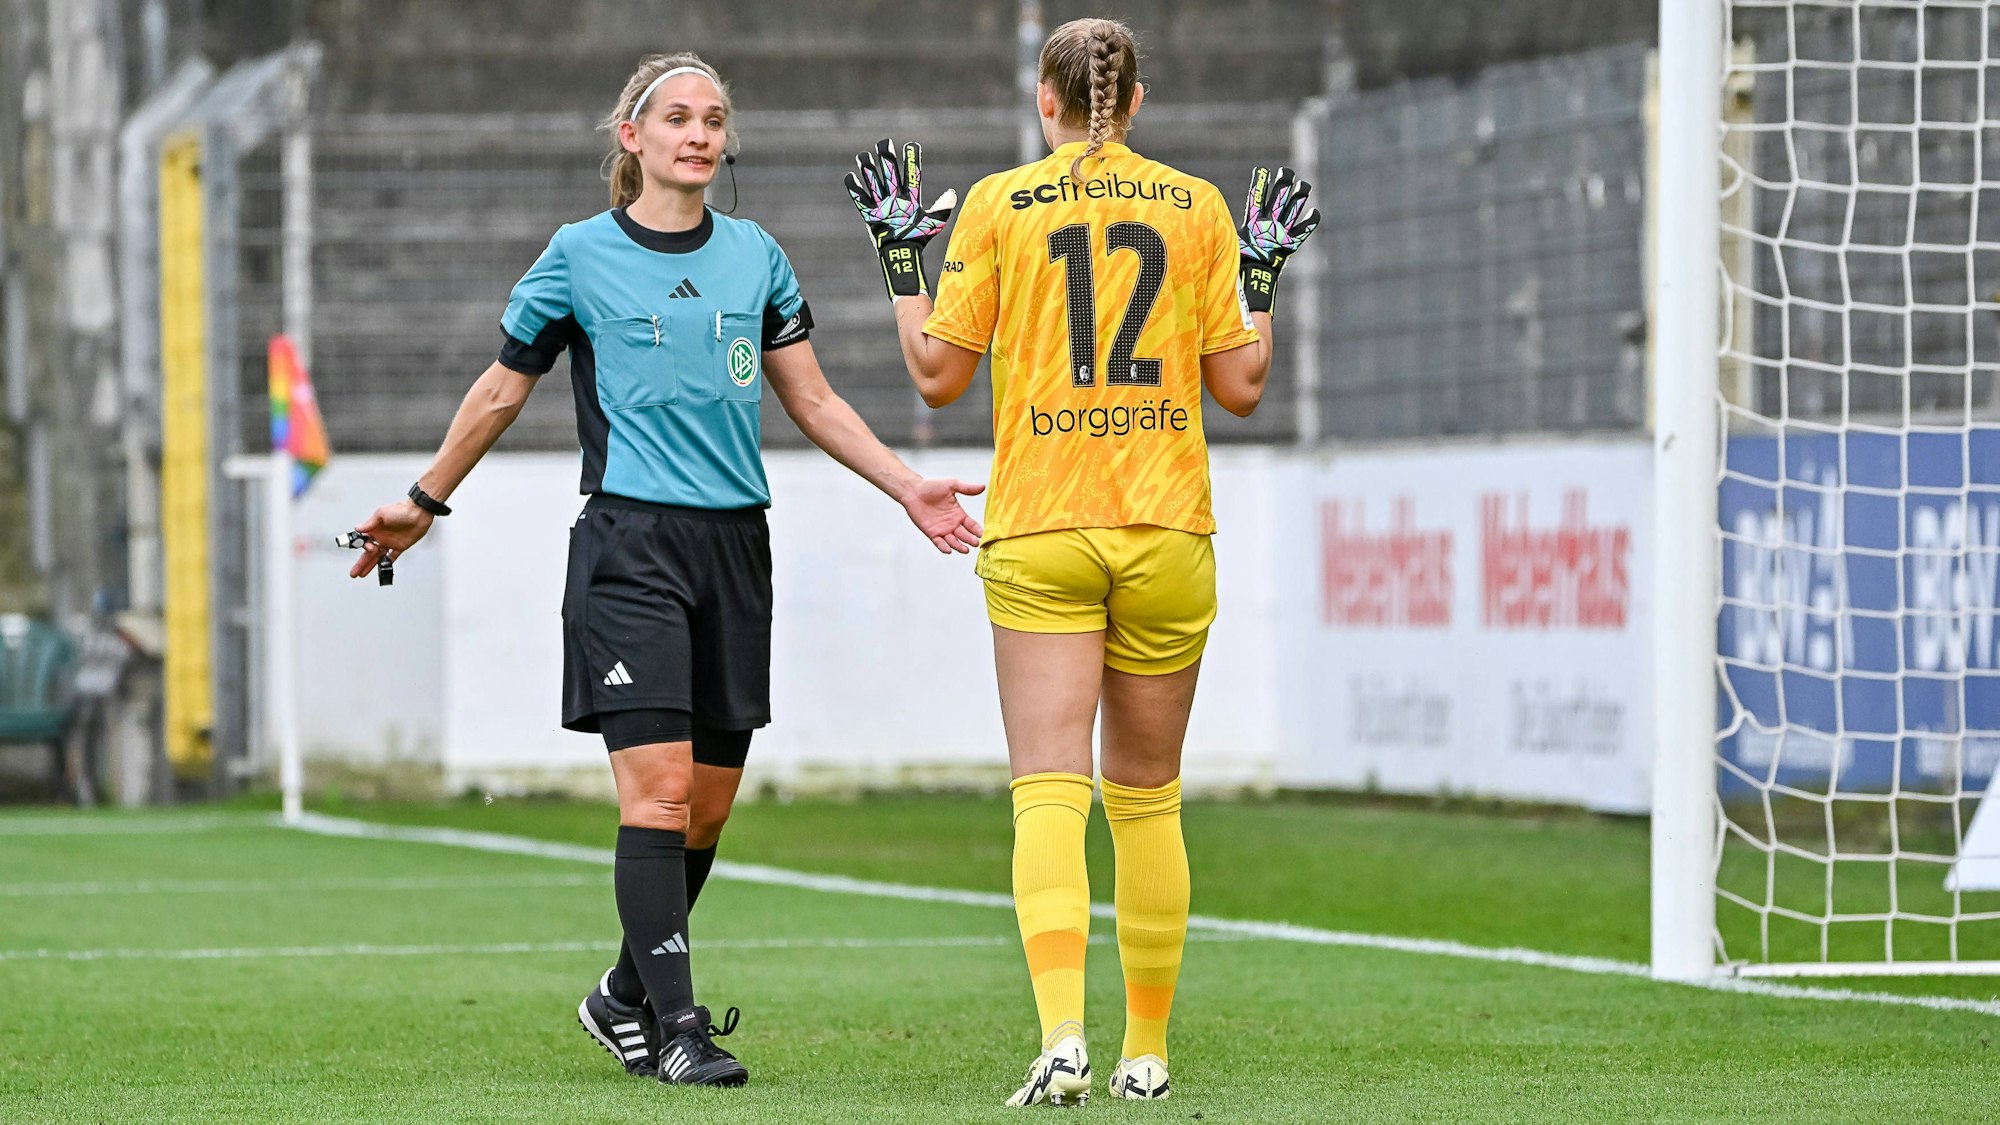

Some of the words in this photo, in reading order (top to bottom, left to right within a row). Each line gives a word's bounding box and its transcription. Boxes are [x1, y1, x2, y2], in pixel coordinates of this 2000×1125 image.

[907, 145, 919, 188] reusch
[1253, 167, 1268, 207] reusch
[889, 248, 912, 261] RB
[892, 261, 913, 274] 12
[1250, 281, 1270, 295] 12
[1251, 268, 1272, 283] RB
[1046, 221, 1167, 388] 12
[1031, 399, 1188, 437] borggräfe
